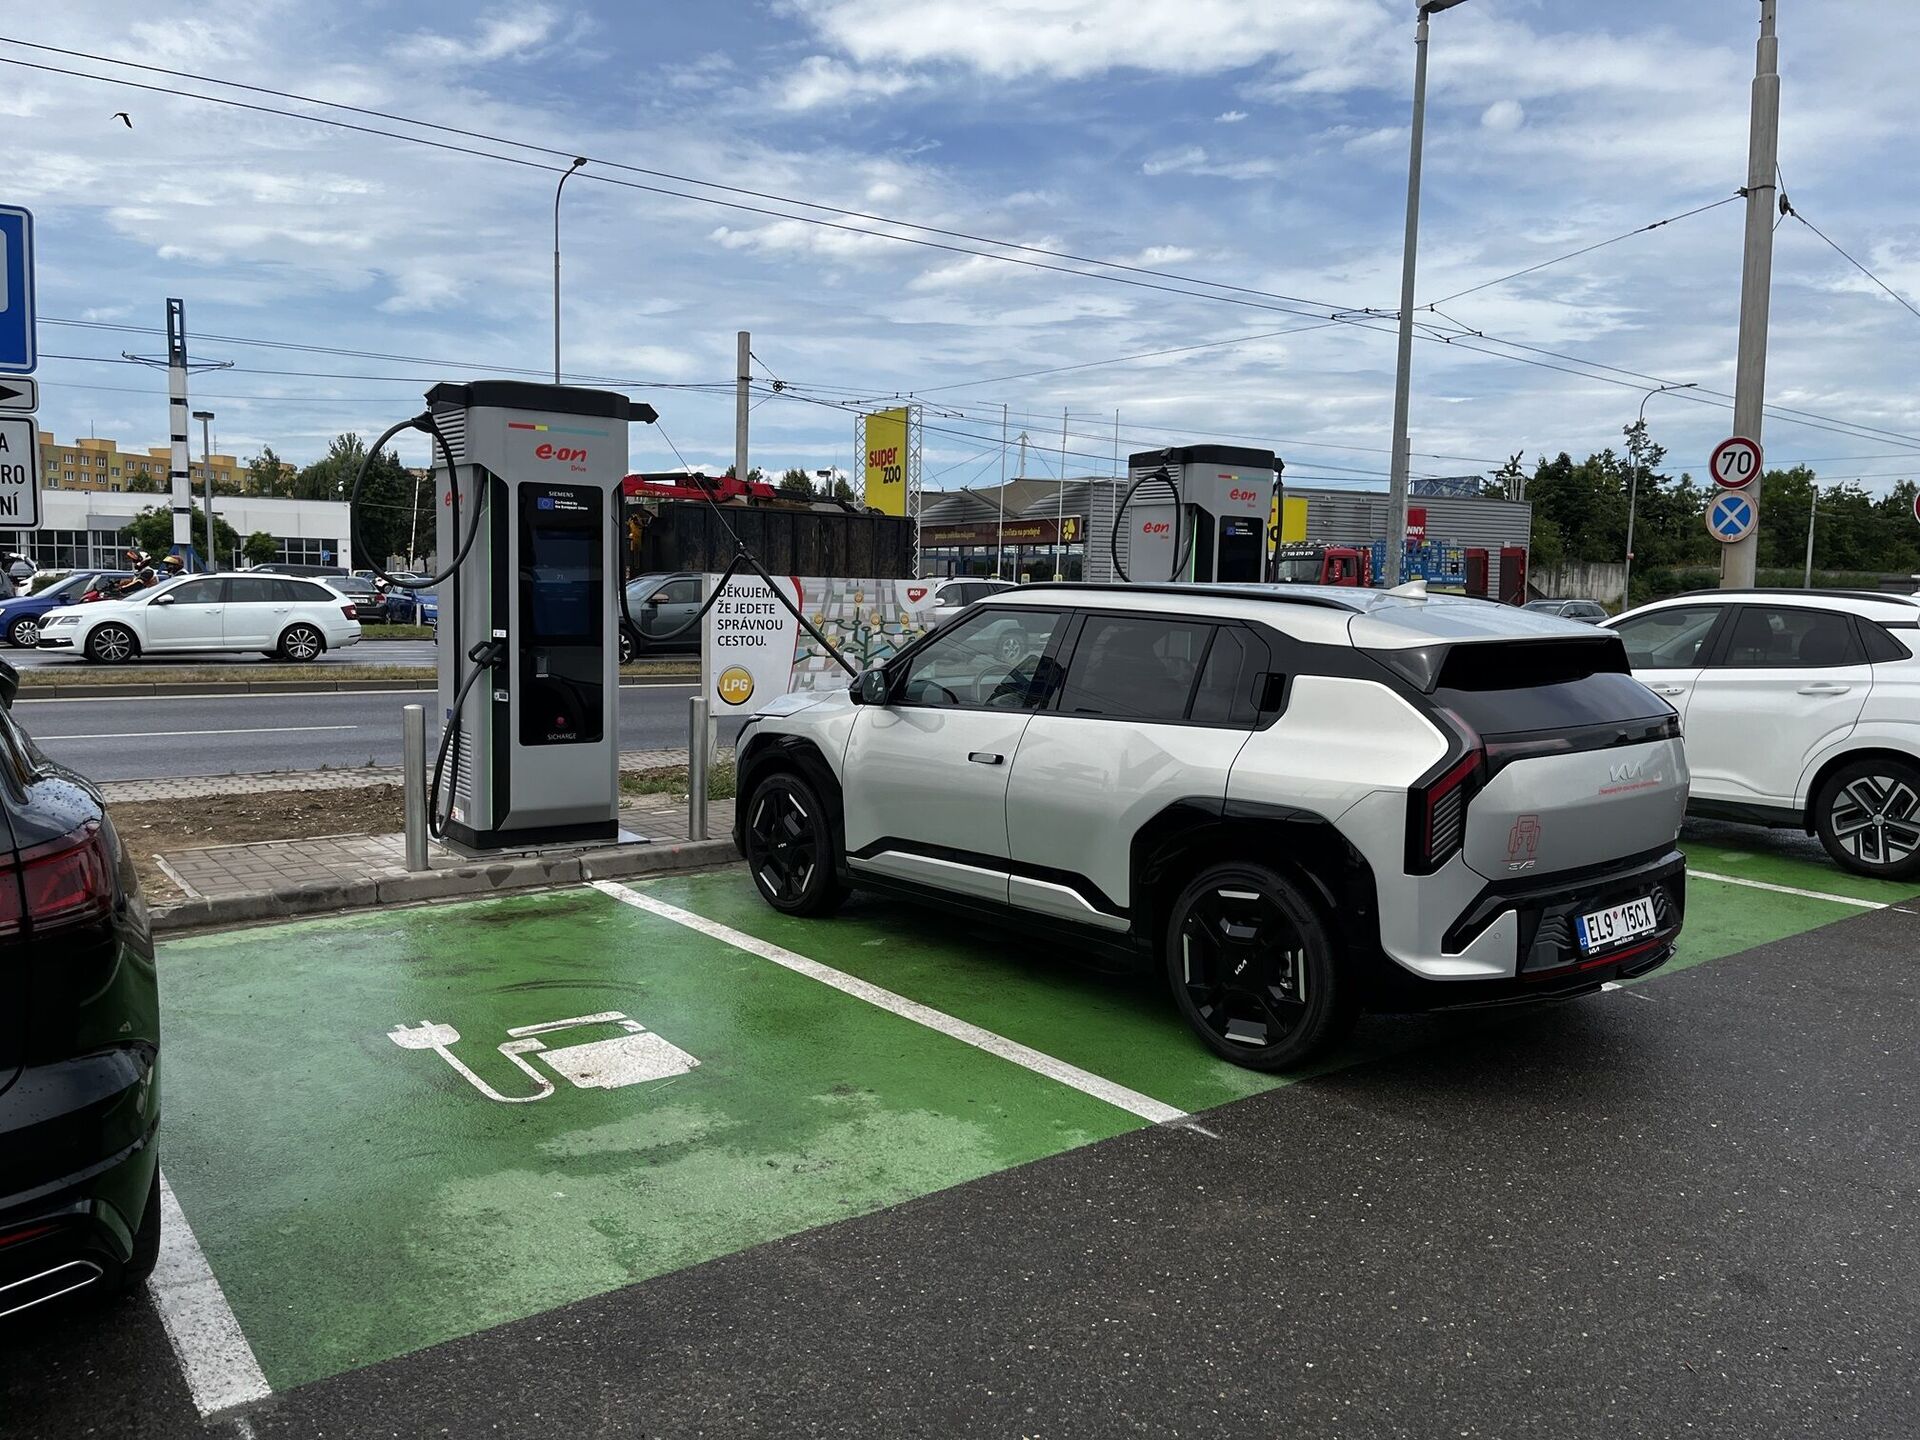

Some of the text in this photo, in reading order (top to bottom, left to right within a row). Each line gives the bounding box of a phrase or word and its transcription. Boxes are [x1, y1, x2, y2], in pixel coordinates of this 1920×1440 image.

[869, 447, 898, 471] super
[1722, 451, 1752, 475] 70
[717, 600, 776, 615] ŽE JEDETE
[717, 616, 783, 631] SPRÁVNOU
[717, 634, 767, 647] CESTOU.
[723, 678, 749, 692] LPG
[1587, 901, 1652, 943] EL9 15CX
